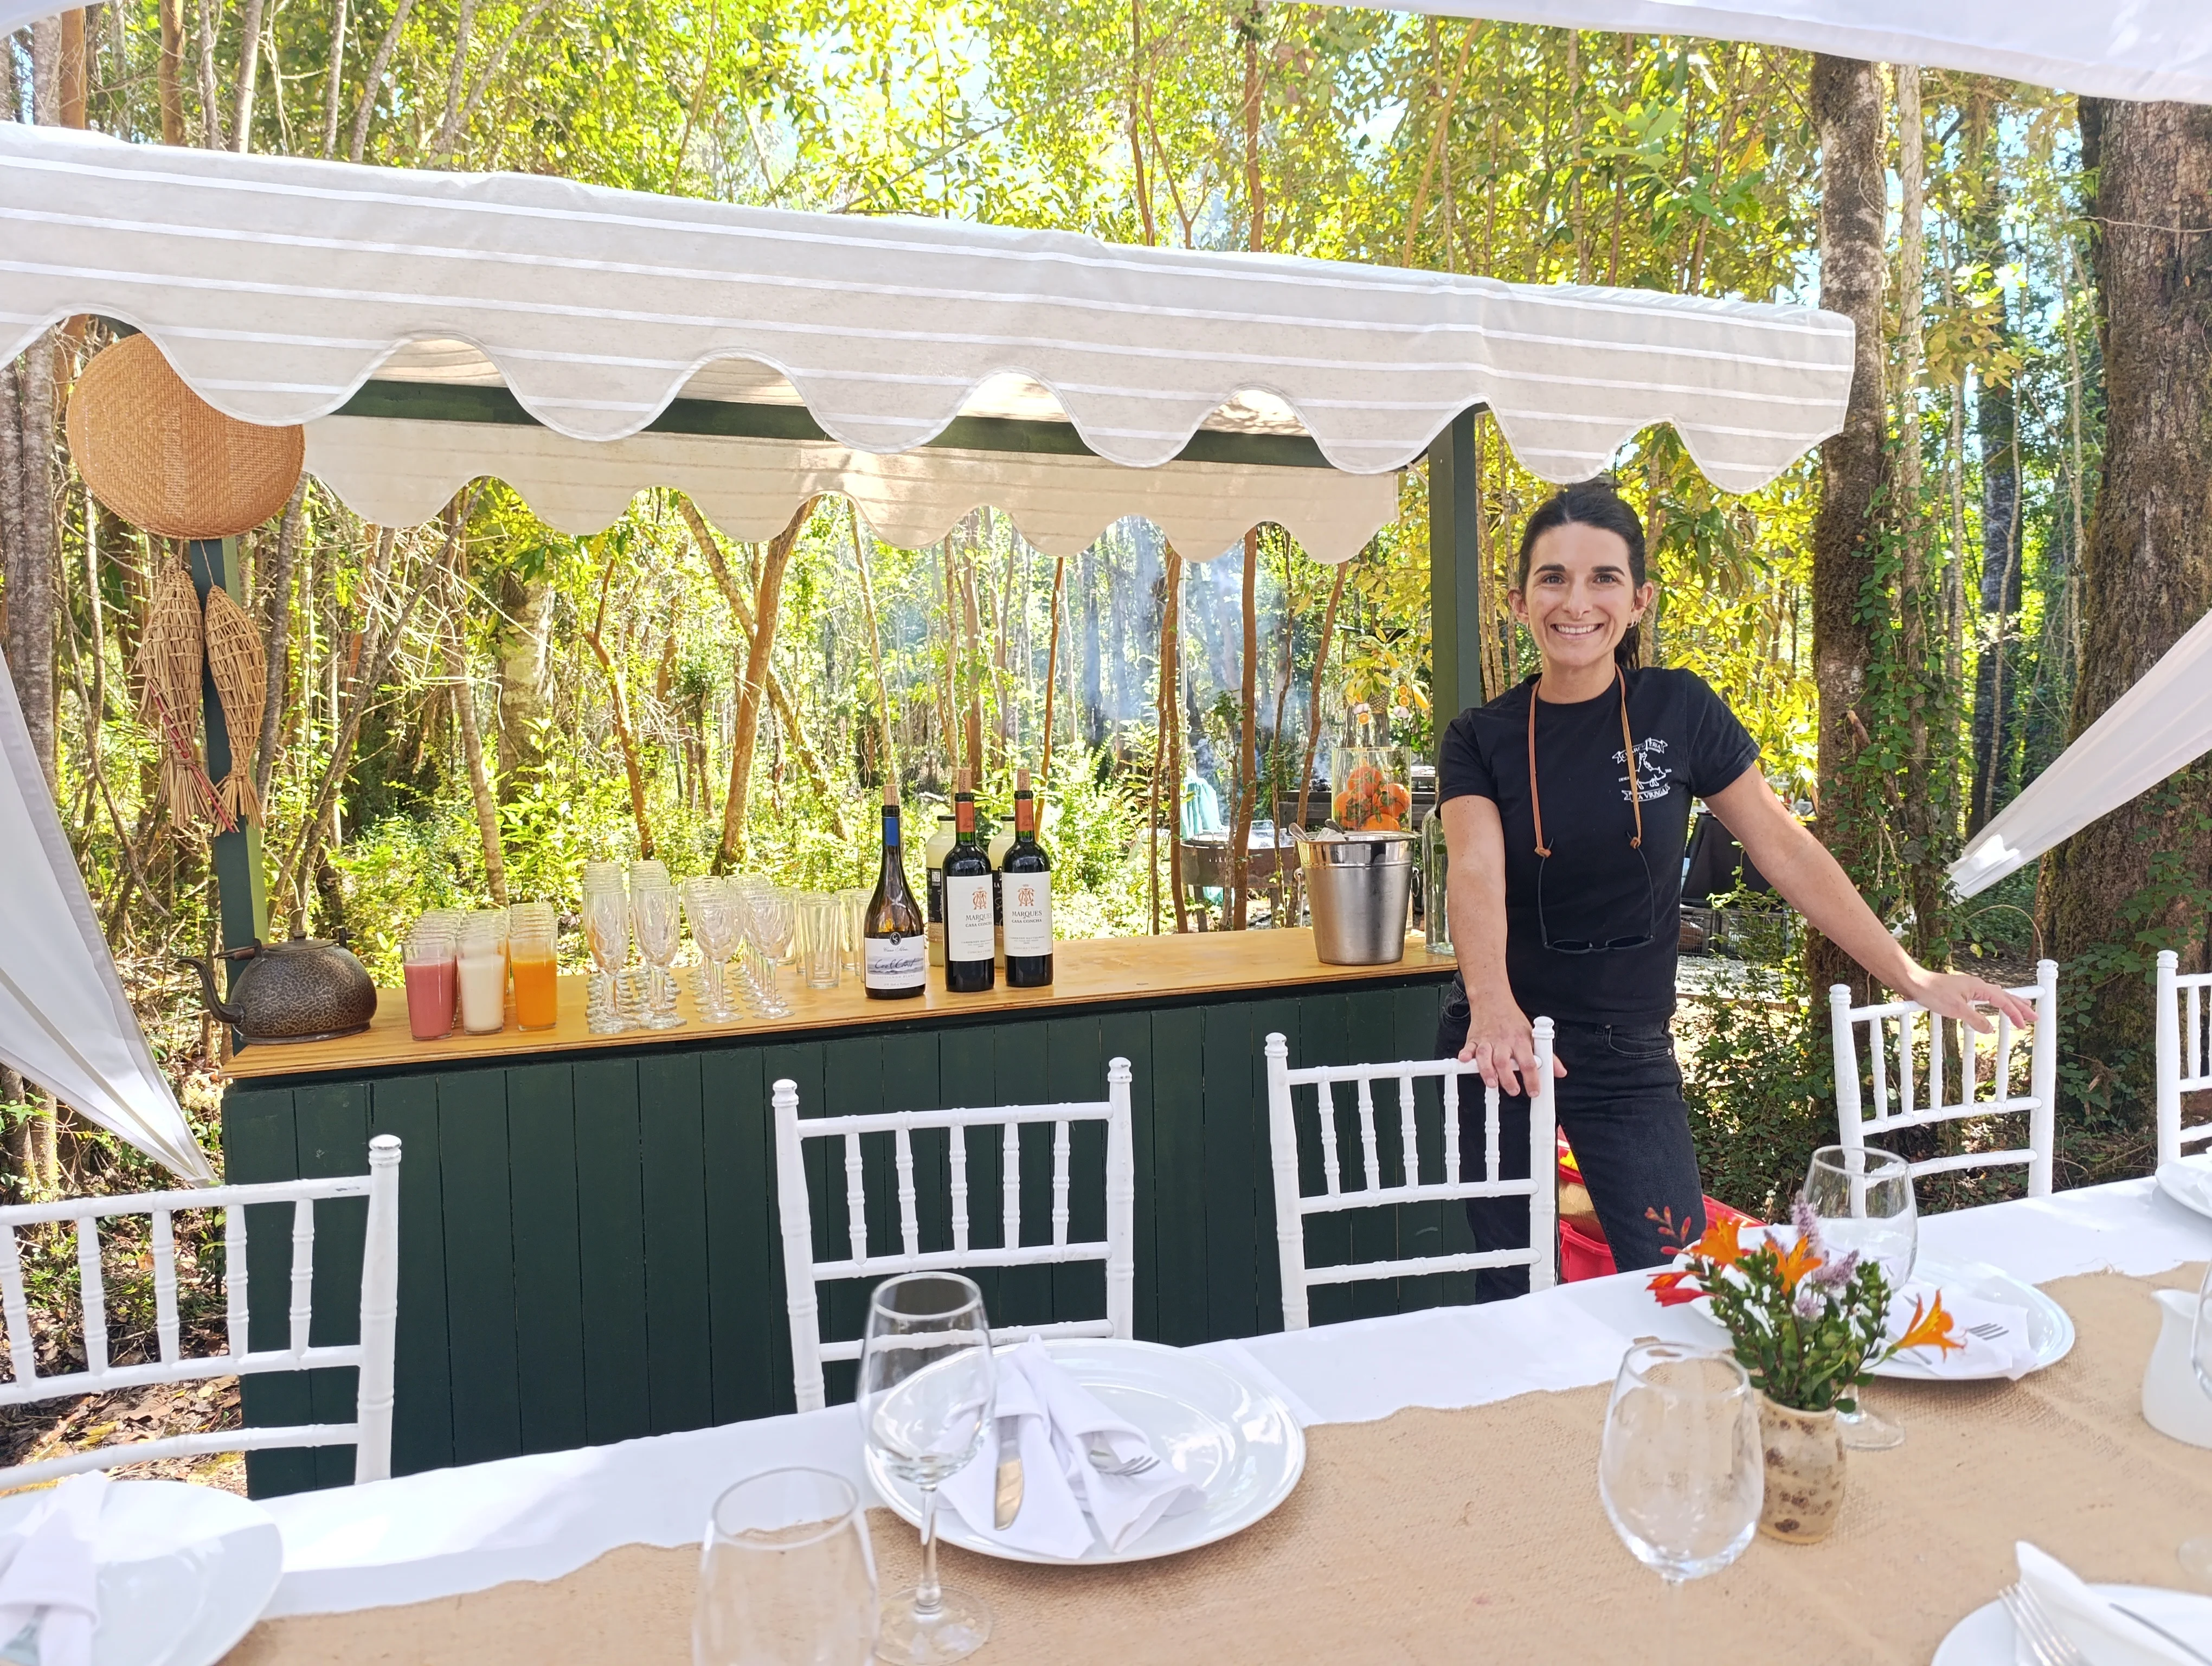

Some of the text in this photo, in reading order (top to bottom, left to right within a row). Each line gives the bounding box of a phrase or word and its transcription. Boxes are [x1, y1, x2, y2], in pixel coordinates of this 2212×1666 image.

[1643, 788, 1666, 799] VIKINGA
[966, 913, 992, 921] MARQUES
[875, 959, 896, 969] Cool
